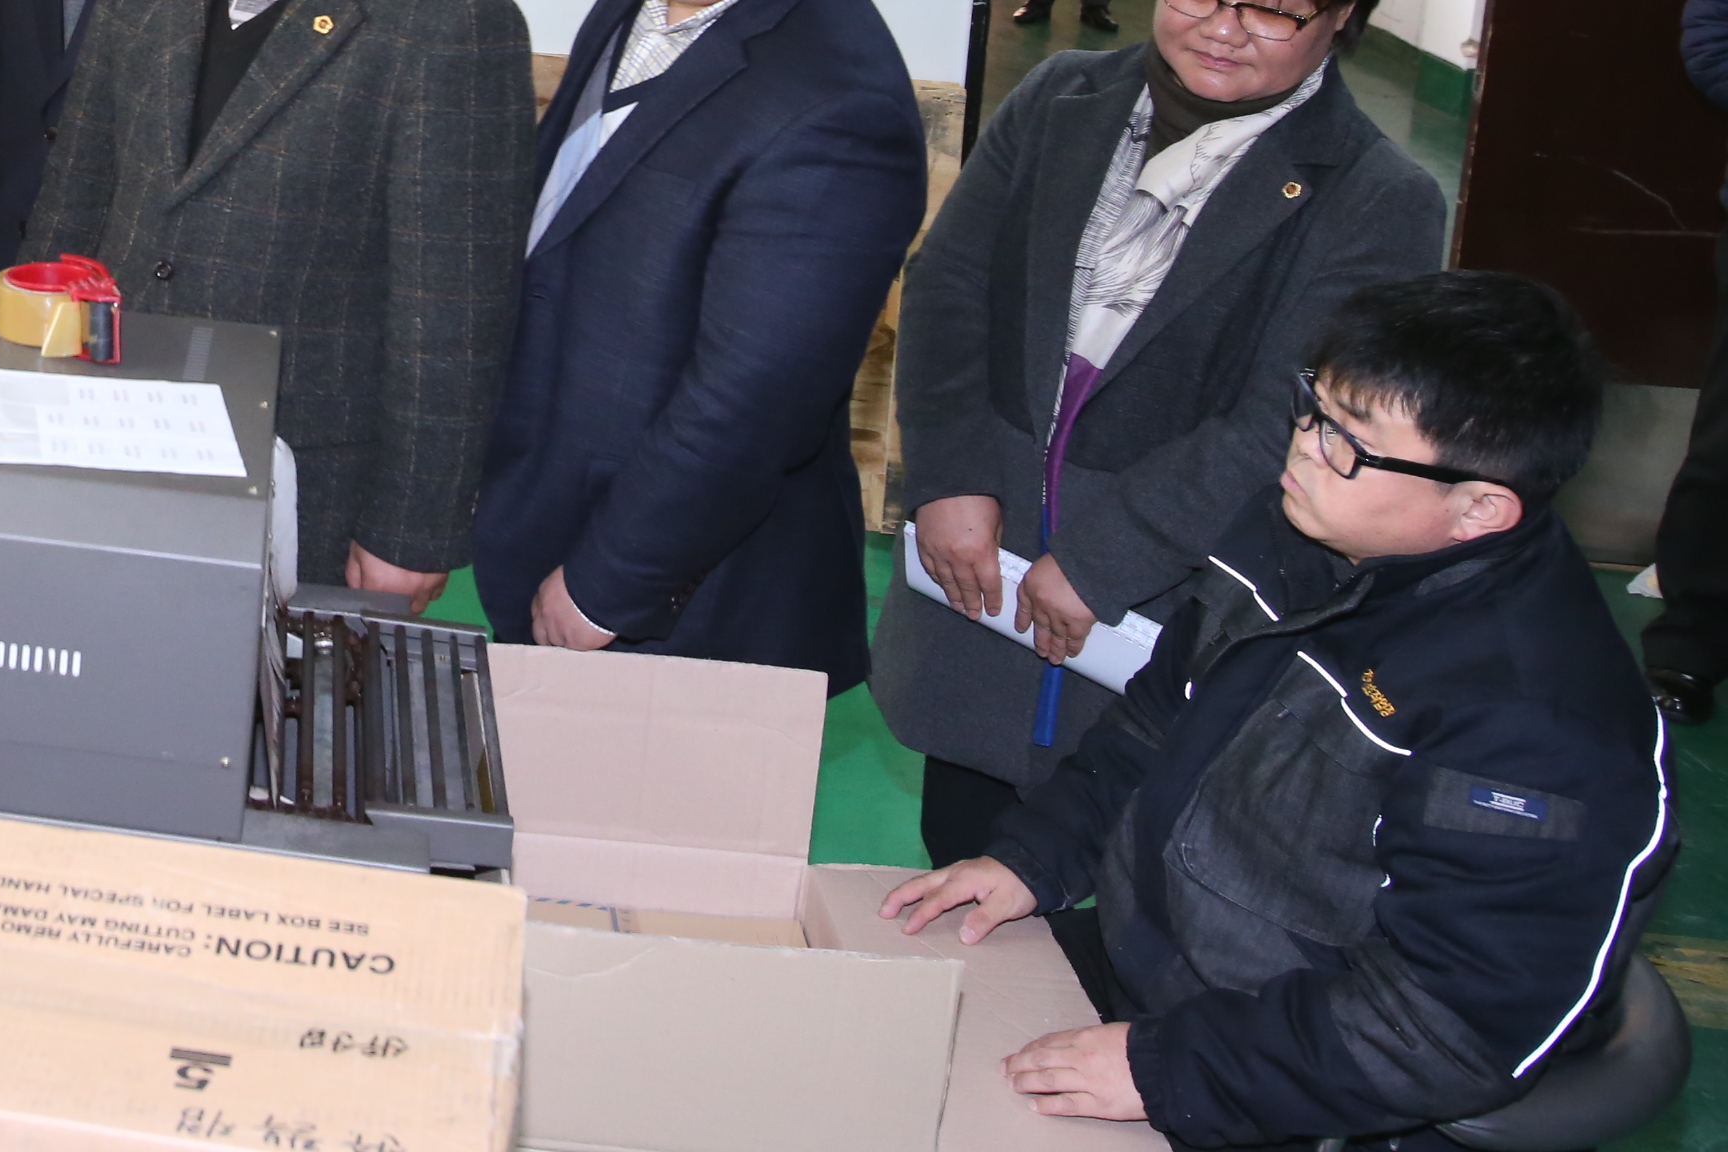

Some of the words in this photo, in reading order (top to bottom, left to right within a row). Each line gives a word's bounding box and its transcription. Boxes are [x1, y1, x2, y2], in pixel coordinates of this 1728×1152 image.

[58, 883, 145, 908] SPECIAL
[56, 912, 97, 928] MAY
[204, 903, 270, 923] LABEL
[277, 912, 321, 930] BOX
[105, 919, 195, 942] CUTTING
[328, 920, 370, 936] SEE
[69, 930, 192, 959] CAREFULLY
[204, 932, 396, 975] CAUTION:
[173, 1064, 215, 1091] 5
